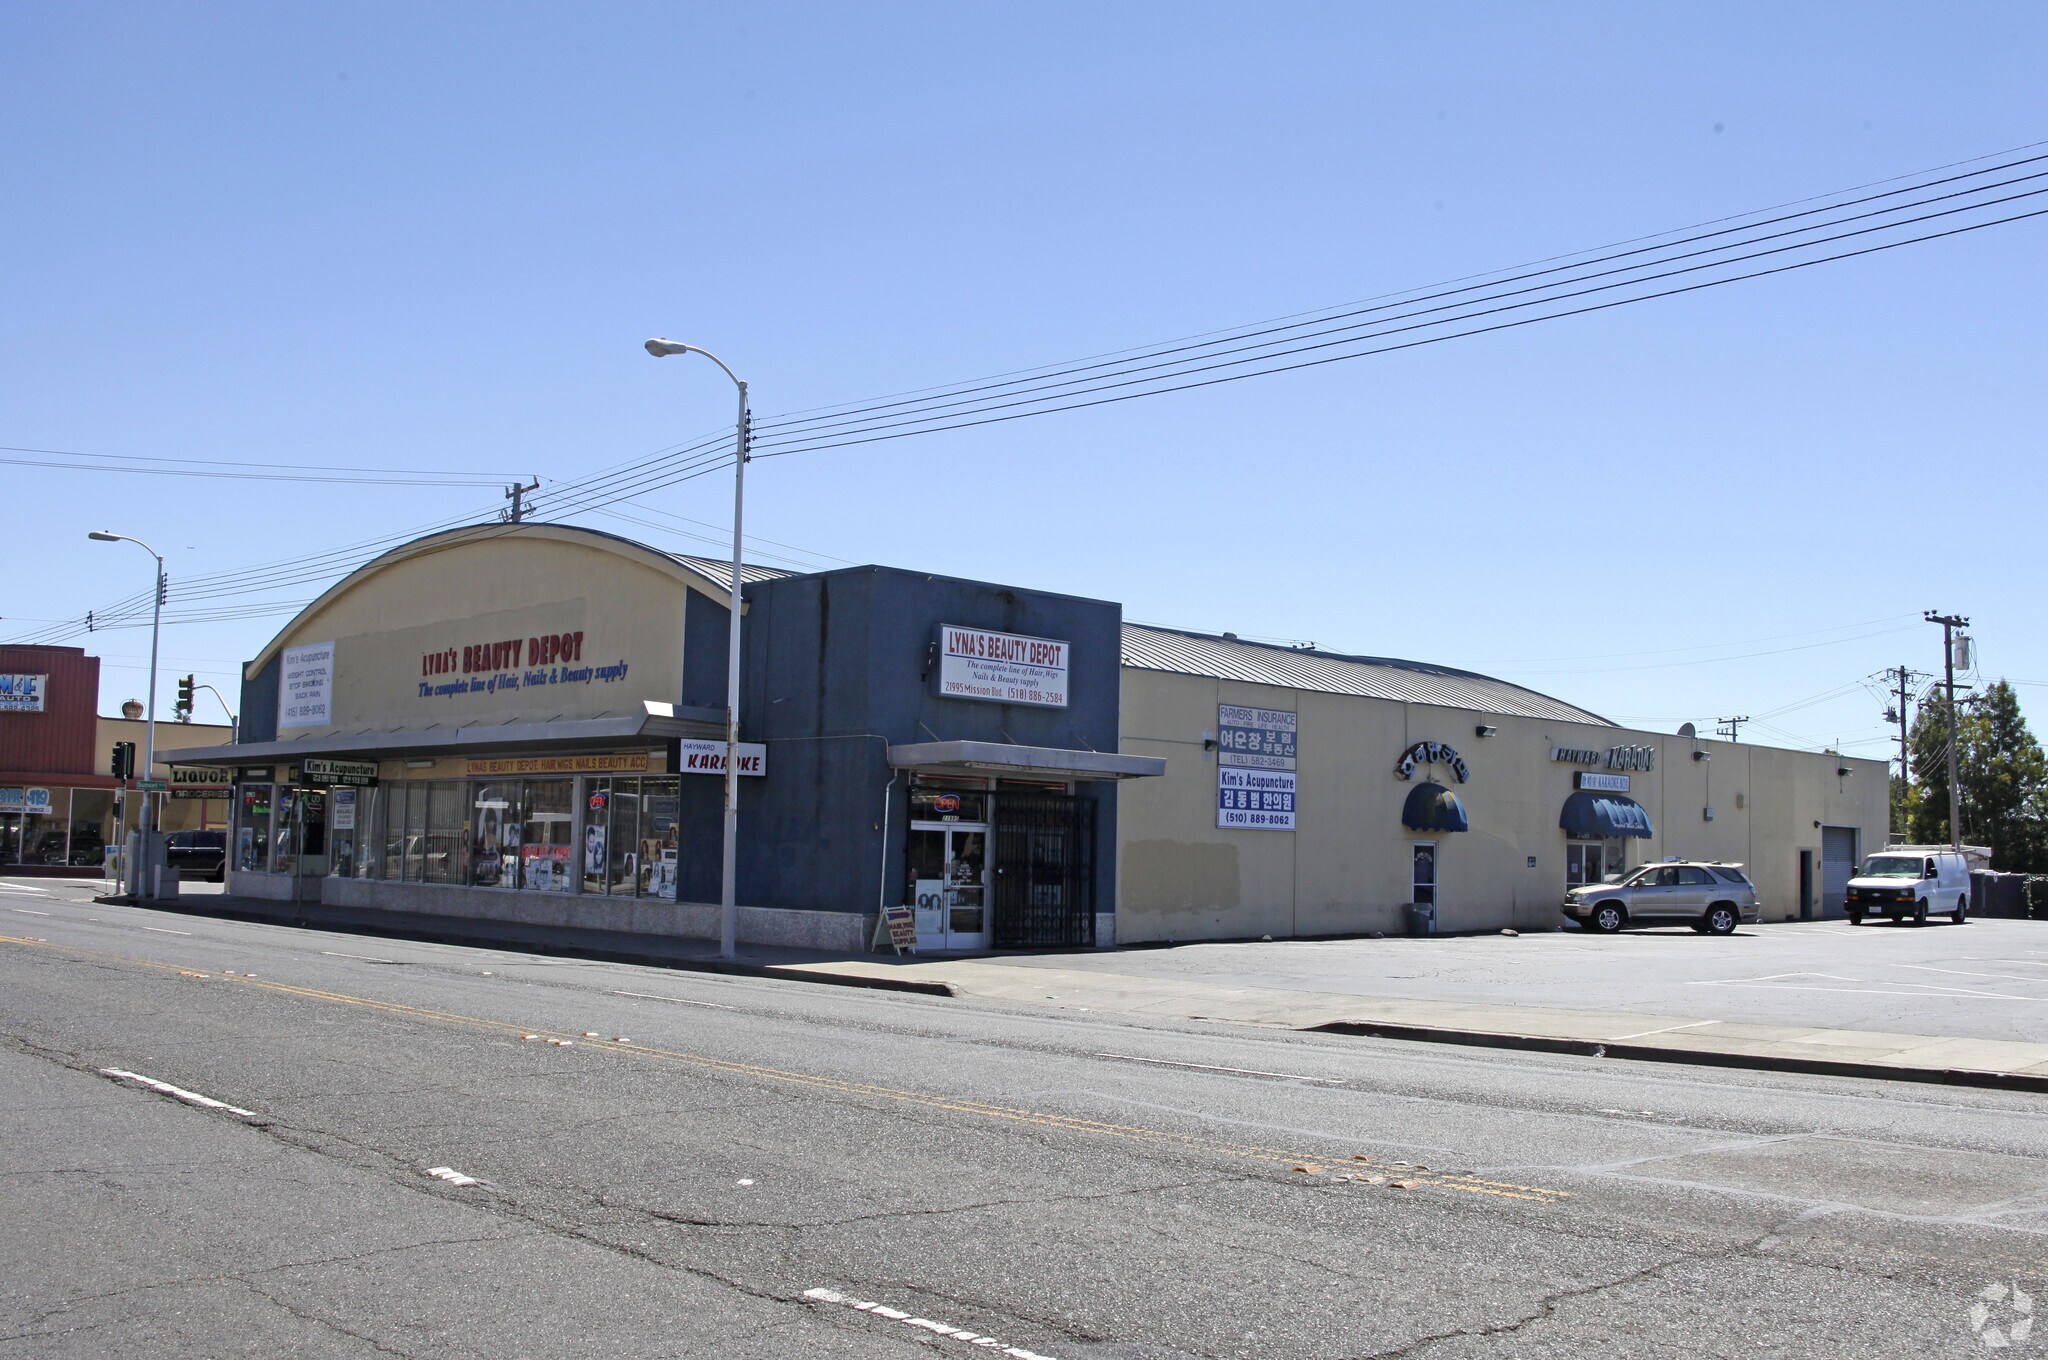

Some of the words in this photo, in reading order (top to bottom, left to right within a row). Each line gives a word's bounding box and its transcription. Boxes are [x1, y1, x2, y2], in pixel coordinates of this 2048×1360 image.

[462, 639, 522, 673] BEAUTY
[528, 631, 583, 666] DEPOT
[949, 631, 984, 656] LYNA'S
[988, 636, 1027, 661] BEAUTY
[1030, 643, 1061, 666] DEPOT
[286, 653, 299, 664] Kim's
[301, 651, 329, 664] Acupuncture
[287, 671, 304, 679] WEIGHT
[305, 668, 327, 677] CONTROL
[966, 660, 979, 668] The
[980, 662, 1007, 673] complete
[1009, 666, 1019, 674] line
[1022, 667, 1028, 676] of
[289, 682, 301, 690] STOP
[302, 679, 323, 688] SMOKING
[418, 682, 433, 697] The
[434, 679, 468, 698] complete
[470, 676, 485, 692] line
[487, 674, 498, 694] of
[499, 673, 519, 691] Hair,
[523, 669, 547, 687] Nails
[550, 668, 557, 684] &
[560, 665, 593, 684] Beauty
[595, 659, 628, 682] supply
[972, 671, 989, 681] Nails
[997, 674, 1019, 684] Beauty
[1020, 678, 1039, 688] supply
[945, 681, 963, 692] 21995
[965, 684, 990, 694] Mission
[1008, 687, 1027, 700] (510)
[1029, 690, 1063, 703] 886-2584
[1220, 707, 1252, 720] FARMERS
[1257, 711, 1295, 725] INSURANCE
[683, 743, 715, 751] HAYWARD
[1264, 743, 1295, 756] 부동산
[489, 760, 514, 771] BEAUTY
[599, 756, 627, 768] BEAUTY
[1230, 754, 1248, 765] (TEL)
[1559, 748, 1601, 764] HAYWARD
[1610, 744, 1655, 772] KARAOKE
[307, 760, 327, 772] Kim's
[329, 762, 375, 775] Acupuncture
[173, 770, 229, 783] LIQUOR
[1221, 771, 1243, 786] Kim's
[1246, 773, 1294, 791] Acupuncture
[934, 797, 960, 810] OPEN
[1224, 790, 1260, 808] 김동범
[1263, 793, 1292, 810] 한의원
[1226, 811, 1247, 824] (510)
[1250, 814, 1289, 825] 889-8062
